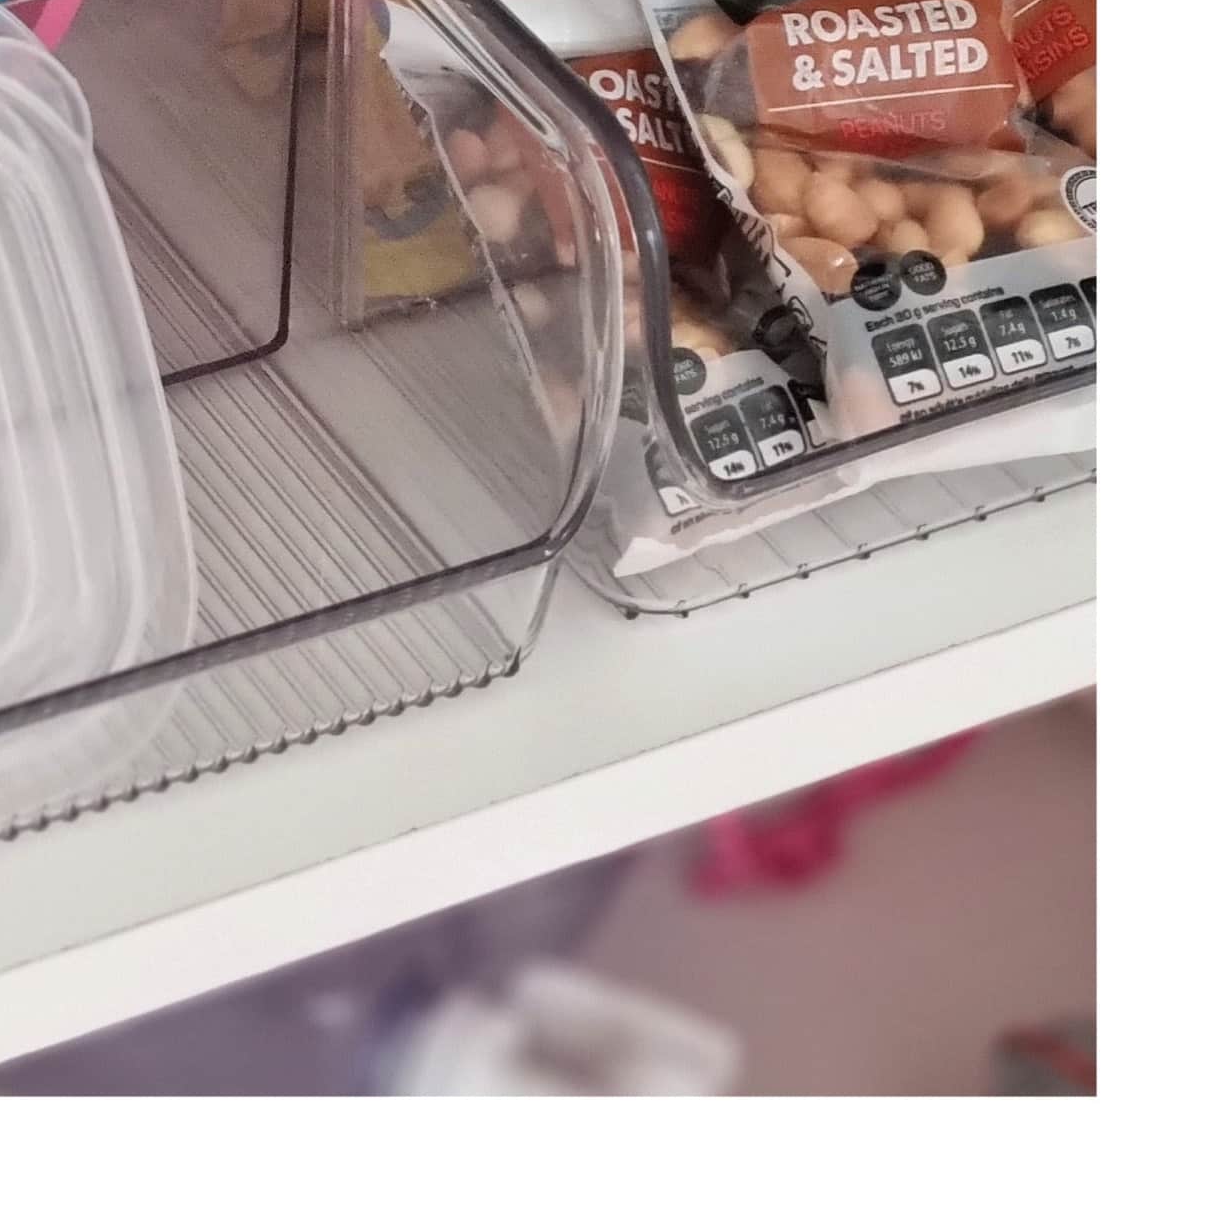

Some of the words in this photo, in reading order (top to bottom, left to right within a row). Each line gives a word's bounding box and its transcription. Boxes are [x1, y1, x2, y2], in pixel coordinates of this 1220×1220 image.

[792, 53, 826, 92] &
[831, 37, 989, 88] SALTED
[837, 108, 948, 141] PEANUTS
[922, 297, 961, 316] serving
